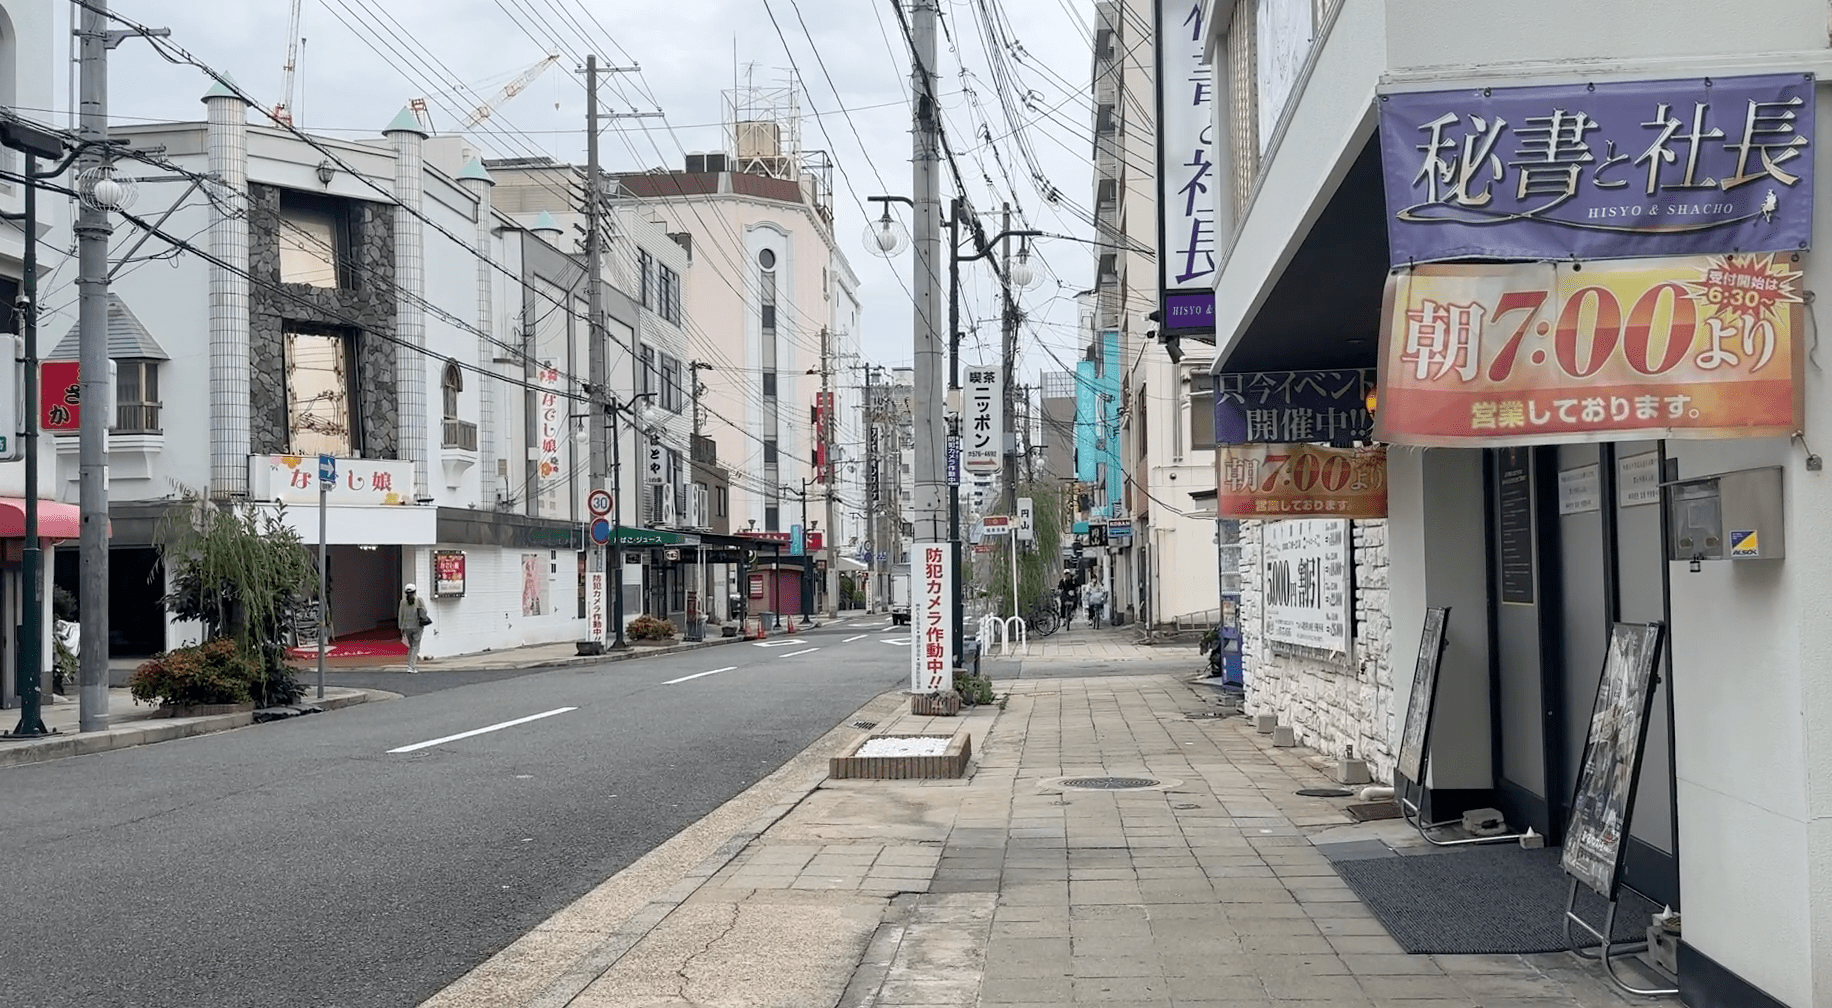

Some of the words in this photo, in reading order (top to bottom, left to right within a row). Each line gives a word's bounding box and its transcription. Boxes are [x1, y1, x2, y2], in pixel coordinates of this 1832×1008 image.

[1412, 97, 1809, 204] 秘書と社長
[1588, 206, 1642, 219] HISYO
[1649, 205, 1659, 217] &
[1667, 203, 1734, 216] SHACHO
[1708, 270, 1779, 291] 受付開始は
[1172, 305, 1202, 316] HISYO
[1401, 283, 1776, 382] 朝7:00より
[969, 371, 995, 384] 喫茶
[974, 387, 991, 449] ニッポン
[1246, 407, 1366, 441] 開催中!!
[1470, 395, 1699, 430] 営業しております。
[291, 469, 392, 492] なし娘
[593, 496, 608, 509] 30
[926, 547, 944, 689] 防犯カメラ作動中!!
